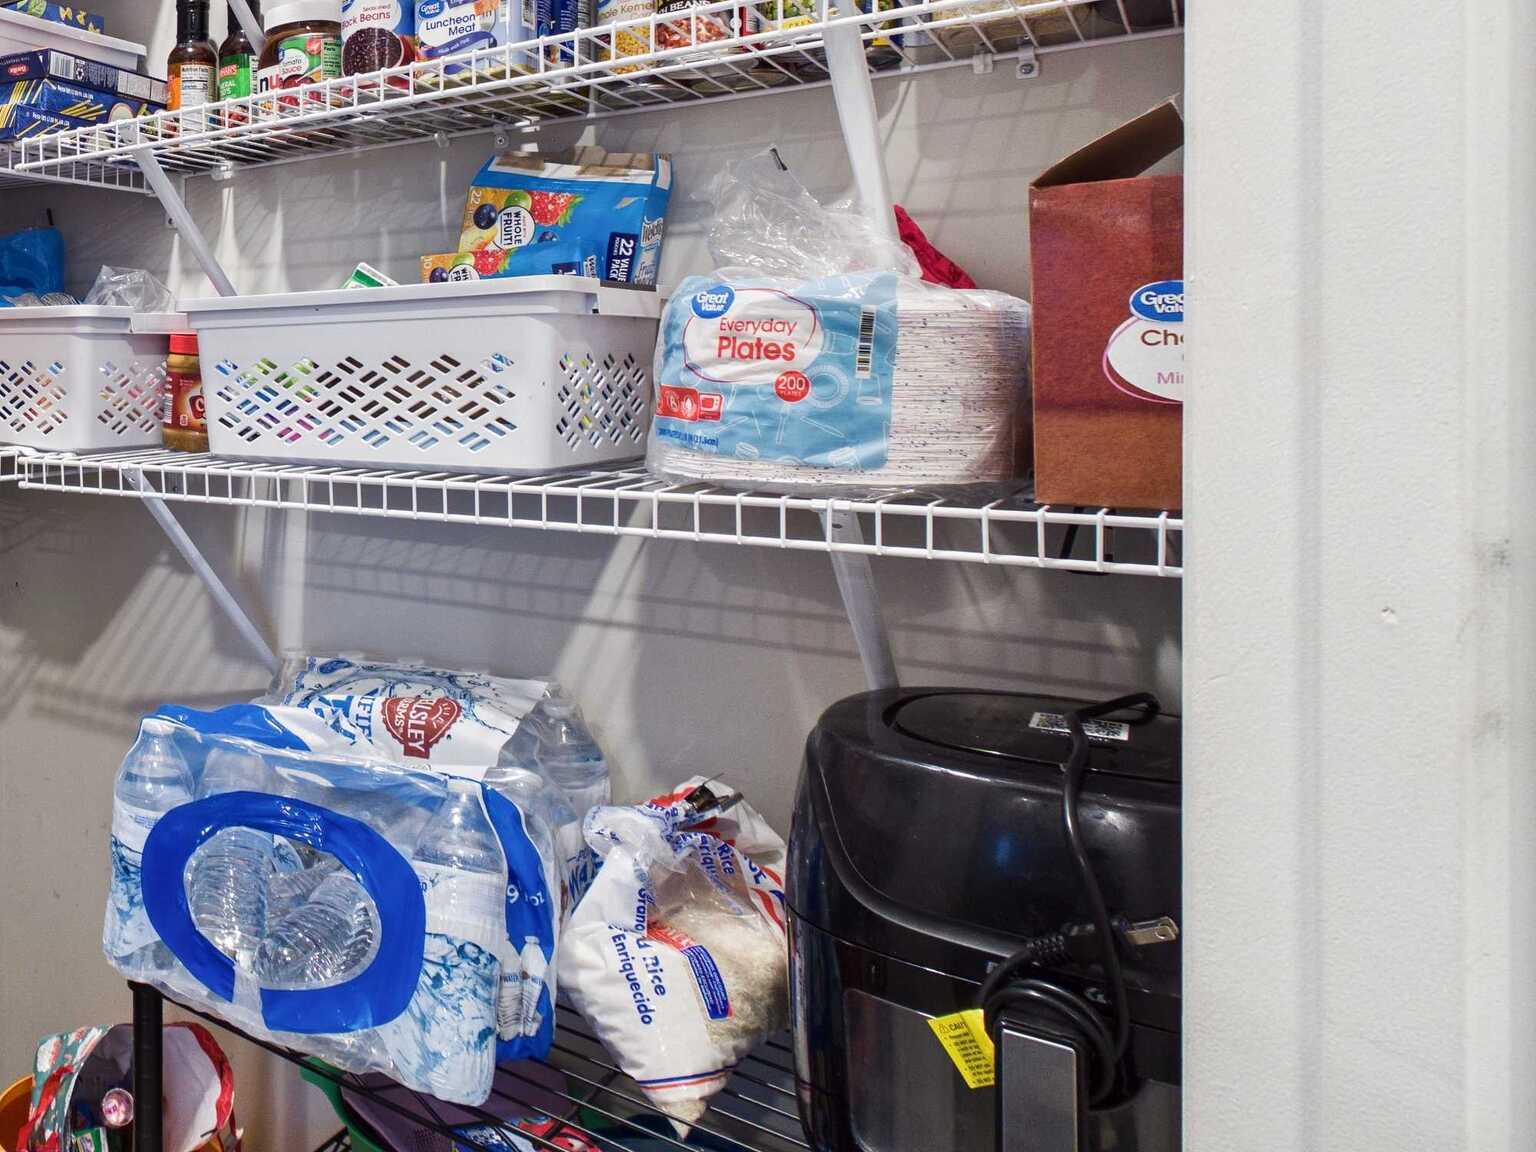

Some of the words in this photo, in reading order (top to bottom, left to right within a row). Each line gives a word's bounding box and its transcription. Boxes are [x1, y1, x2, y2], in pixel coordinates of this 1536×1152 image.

[359, 10, 392, 24] Beans
[425, 12, 477, 31] Luncheon
[447, 22, 477, 38] Meat
[503, 211, 512, 246] FRUIT!
[513, 210, 522, 245] WHOLE
[619, 238, 635, 257] 22
[609, 258, 621, 279] PACK
[617, 257, 631, 282] VALUE
[696, 291, 730, 307] Great
[700, 301, 725, 313] Value
[1140, 291, 1184, 306] Gre
[719, 317, 798, 336] Everyday
[716, 335, 797, 362] Plates
[776, 376, 806, 392] 200
[716, 841, 735, 875] Rice
[634, 886, 648, 934] Grano
[611, 929, 654, 1025] Enriquecido
[643, 953, 666, 997] Rice
